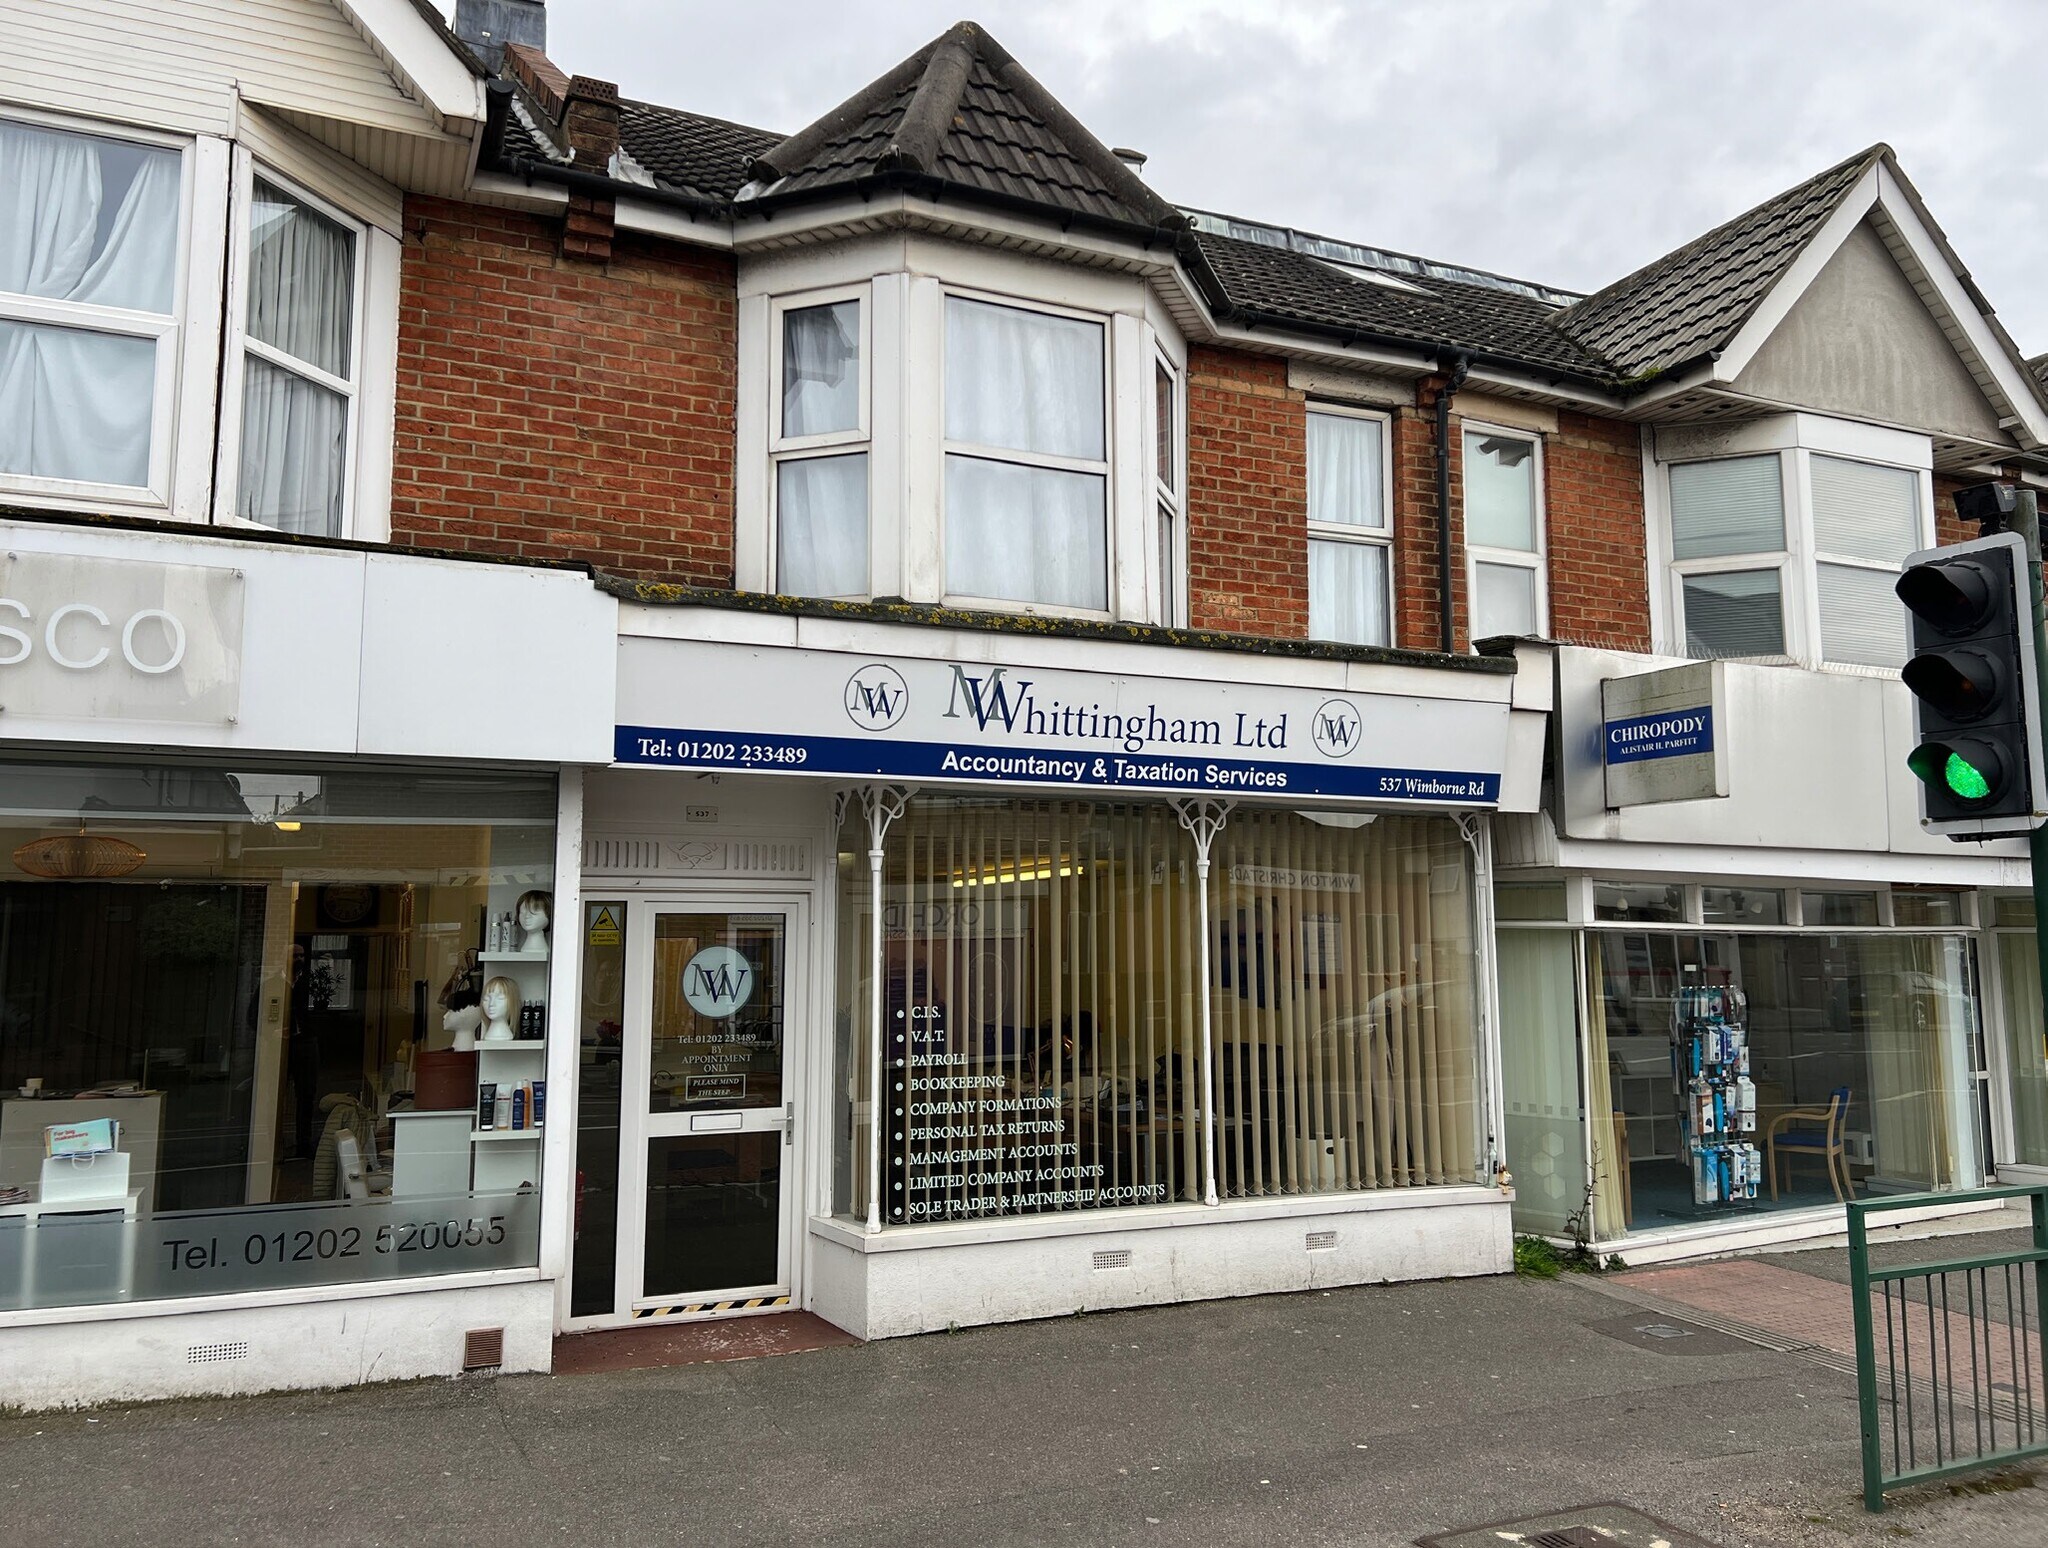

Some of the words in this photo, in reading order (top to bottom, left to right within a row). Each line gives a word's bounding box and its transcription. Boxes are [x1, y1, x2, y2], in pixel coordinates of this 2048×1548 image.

[1235, 712, 1288, 749] Ltd
[1611, 716, 1705, 743] CHIROPODY
[638, 739, 672, 758] Tel:
[678, 741, 735, 760] 01202
[739, 745, 807, 764] 233489
[1621, 743, 1654, 755] ALISTAIR
[1665, 737, 1697, 748] PARFITT
[942, 751, 1085, 781] Accountancy
[1092, 759, 1107, 777] &
[1114, 759, 1199, 782] Taxation
[1205, 765, 1287, 787] Services
[1379, 777, 1401, 792] 537
[1404, 778, 1465, 795] Wimborne
[1468, 781, 1485, 795] Rd
[912, 1006, 941, 1019] C.I.S.
[678, 1035, 693, 1044] Tel:
[695, 1035, 723, 1043] 01202
[724, 1034, 756, 1043] 233489
[912, 1030, 944, 1042] V.A.T.
[682, 1054, 752, 1064] APPOINTMENT
[911, 1054, 968, 1067] PAYROLL
[704, 1064, 729, 1073] ONLY
[692, 1078, 718, 1087] PLEASE
[718, 1077, 740, 1086] MIND
[910, 1076, 1006, 1091] BOOKKEEPING
[697, 1089, 712, 1097] THE
[910, 1100, 976, 1116] COMPANY
[978, 1097, 1061, 1112] FORMATIONS
[910, 1127, 977, 1140] PERSONAL
[980, 1124, 1005, 1136] TAX
[1008, 1120, 1065, 1134] RETURNS
[910, 1148, 1005, 1166] MANAGEMENT
[1008, 1143, 1078, 1158] ACCOUNTS
[909, 1175, 964, 1190] LIMITED
[968, 1169, 1032, 1186] COMPANY
[1035, 1165, 1104, 1181] ACCOUNTS
[910, 1201, 941, 1215] SOLE
[945, 1198, 998, 1212] TRADER
[1000, 1197, 1010, 1208] &
[1012, 1190, 1096, 1206] PARTNERSHIP
[1099, 1183, 1165, 1200] ACCOUNTS
[163, 1238, 228, 1271] Tel.
[244, 1227, 361, 1266] 01202
[375, 1215, 506, 1255] 520055
